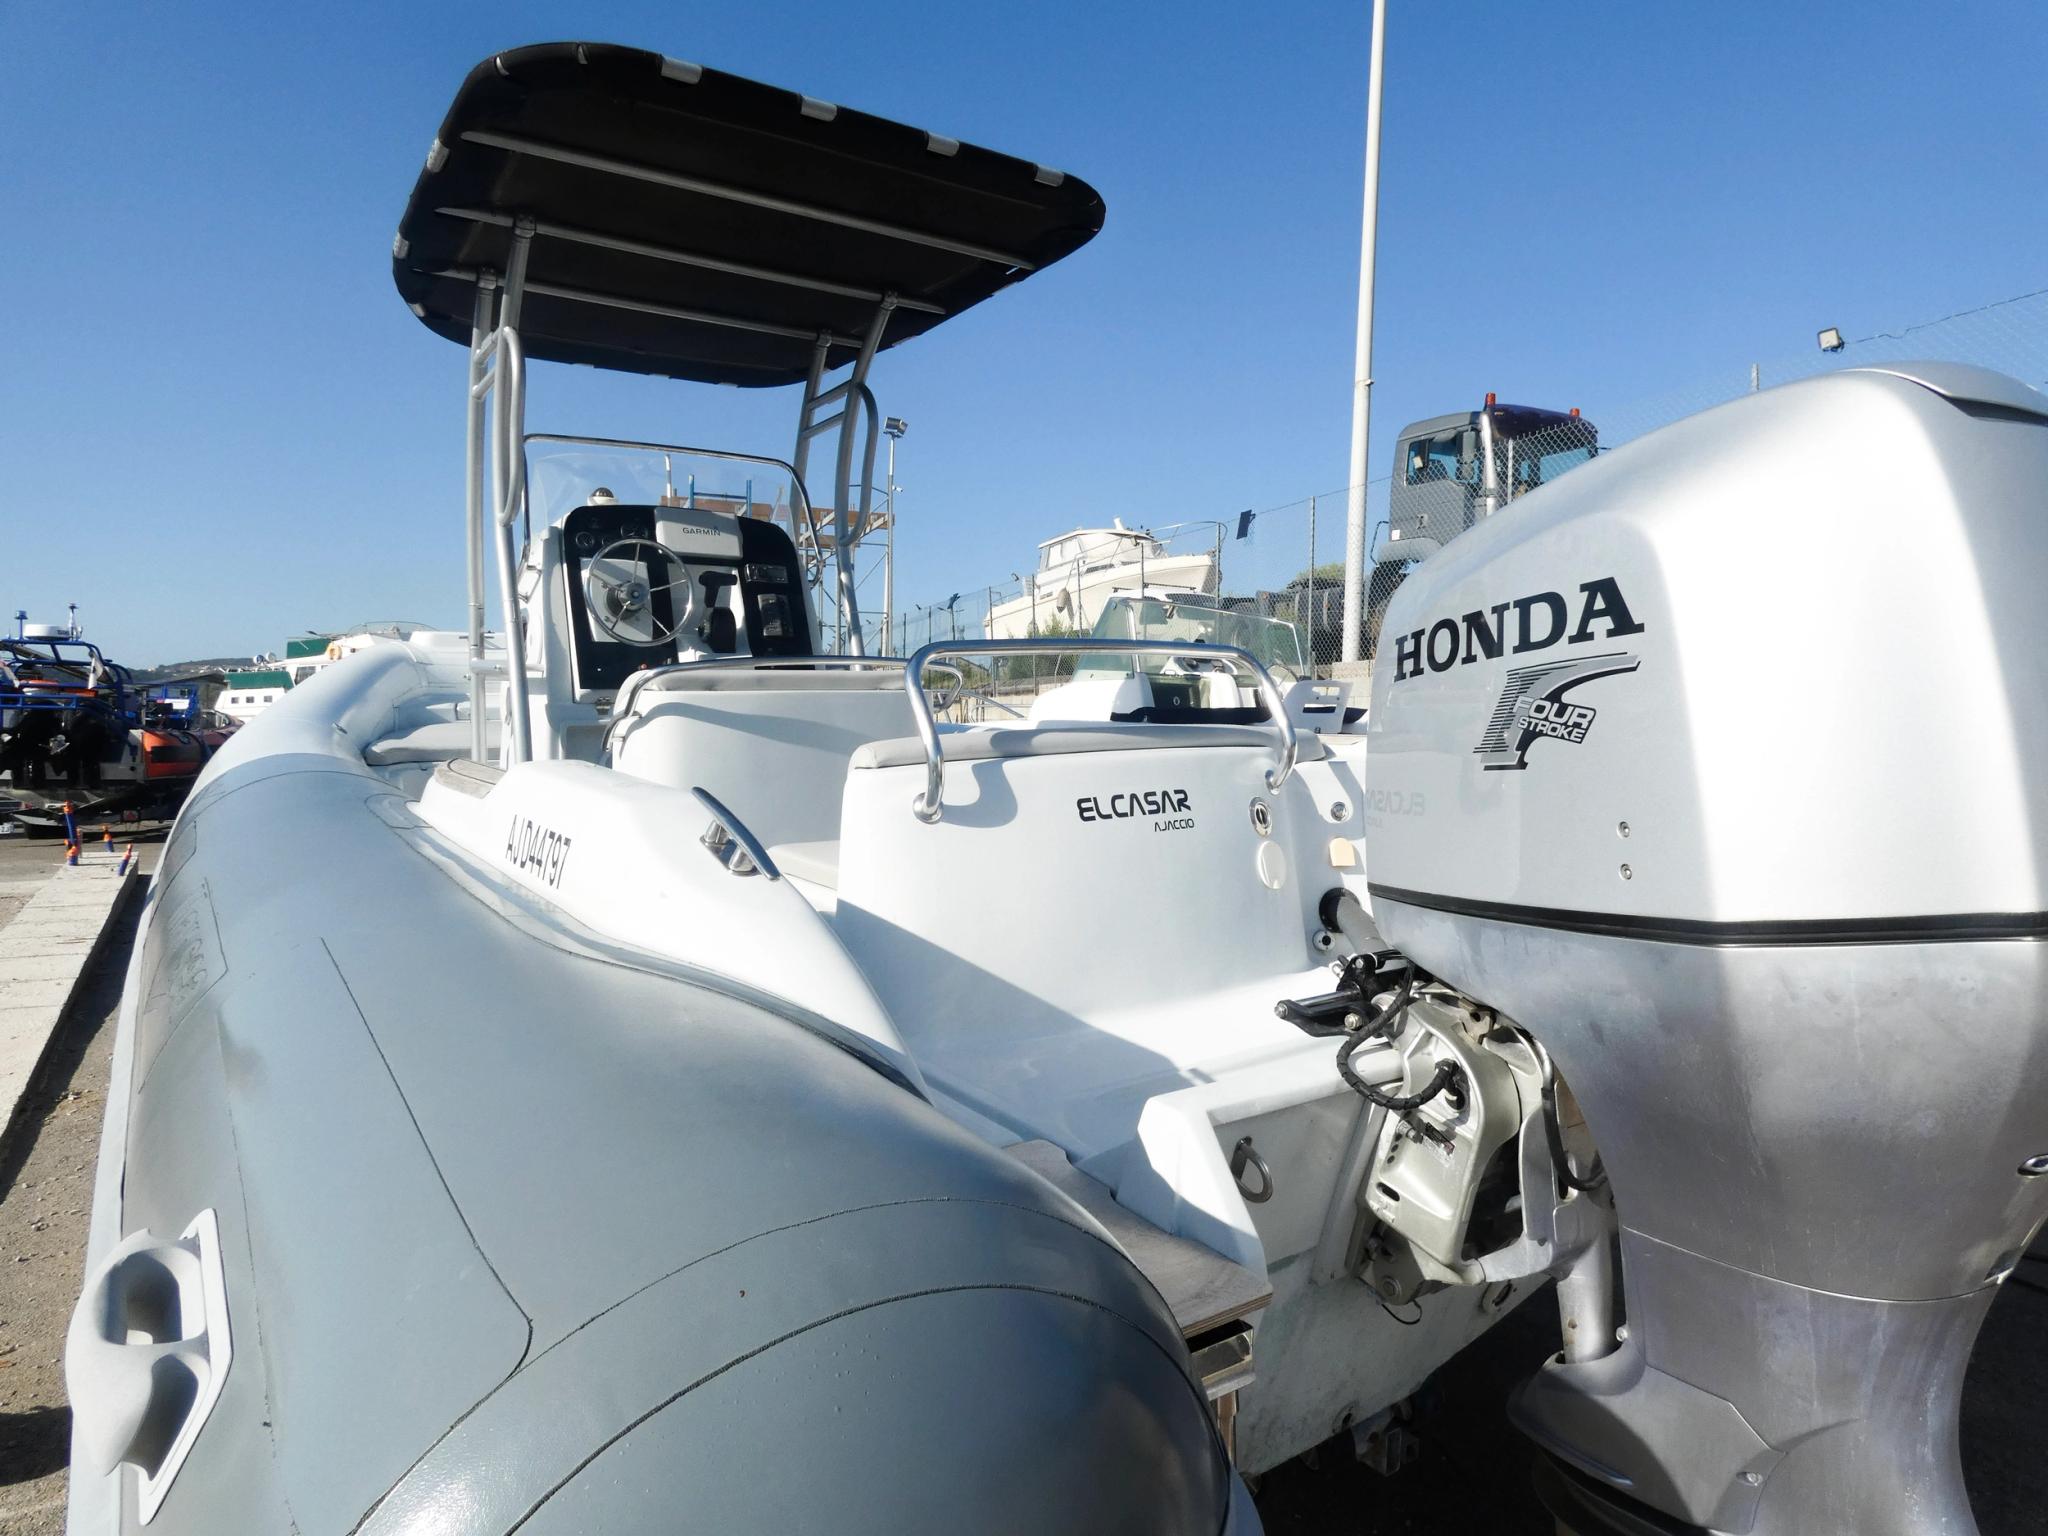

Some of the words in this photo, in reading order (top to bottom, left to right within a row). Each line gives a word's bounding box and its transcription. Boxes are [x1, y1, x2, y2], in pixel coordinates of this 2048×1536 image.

[682, 527, 721, 537] GARMIN
[1394, 576, 1645, 682] HONDA
[1512, 695, 1594, 729] FOUR
[1517, 716, 1586, 742] STROKE
[1076, 789, 1192, 822] ELCASAR
[1154, 818, 1195, 832] AJACCIO
